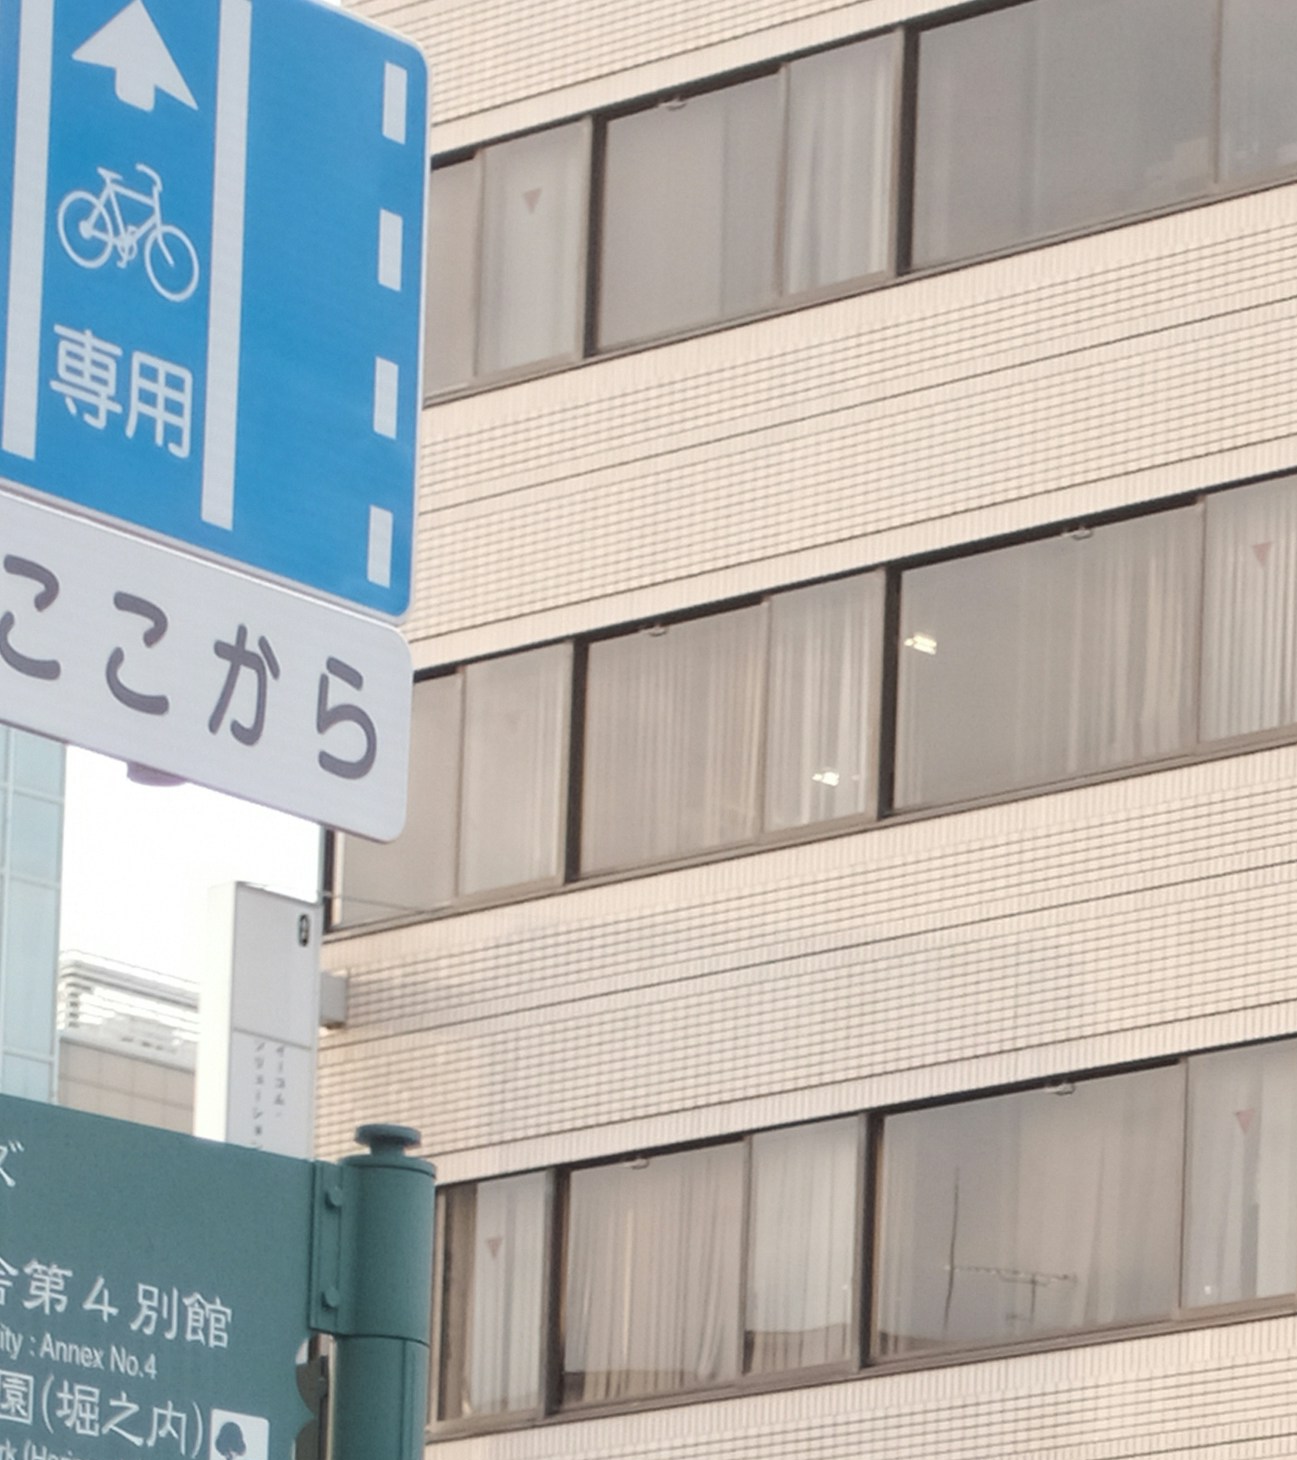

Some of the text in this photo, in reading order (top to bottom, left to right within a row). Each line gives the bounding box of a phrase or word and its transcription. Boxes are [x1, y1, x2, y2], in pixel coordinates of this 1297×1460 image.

[50, 322, 194, 460] 専用
[0, 553, 379, 780] ここから
[39, 1332, 104, 1371] Annex
[110, 1345, 157, 1380] No.4
